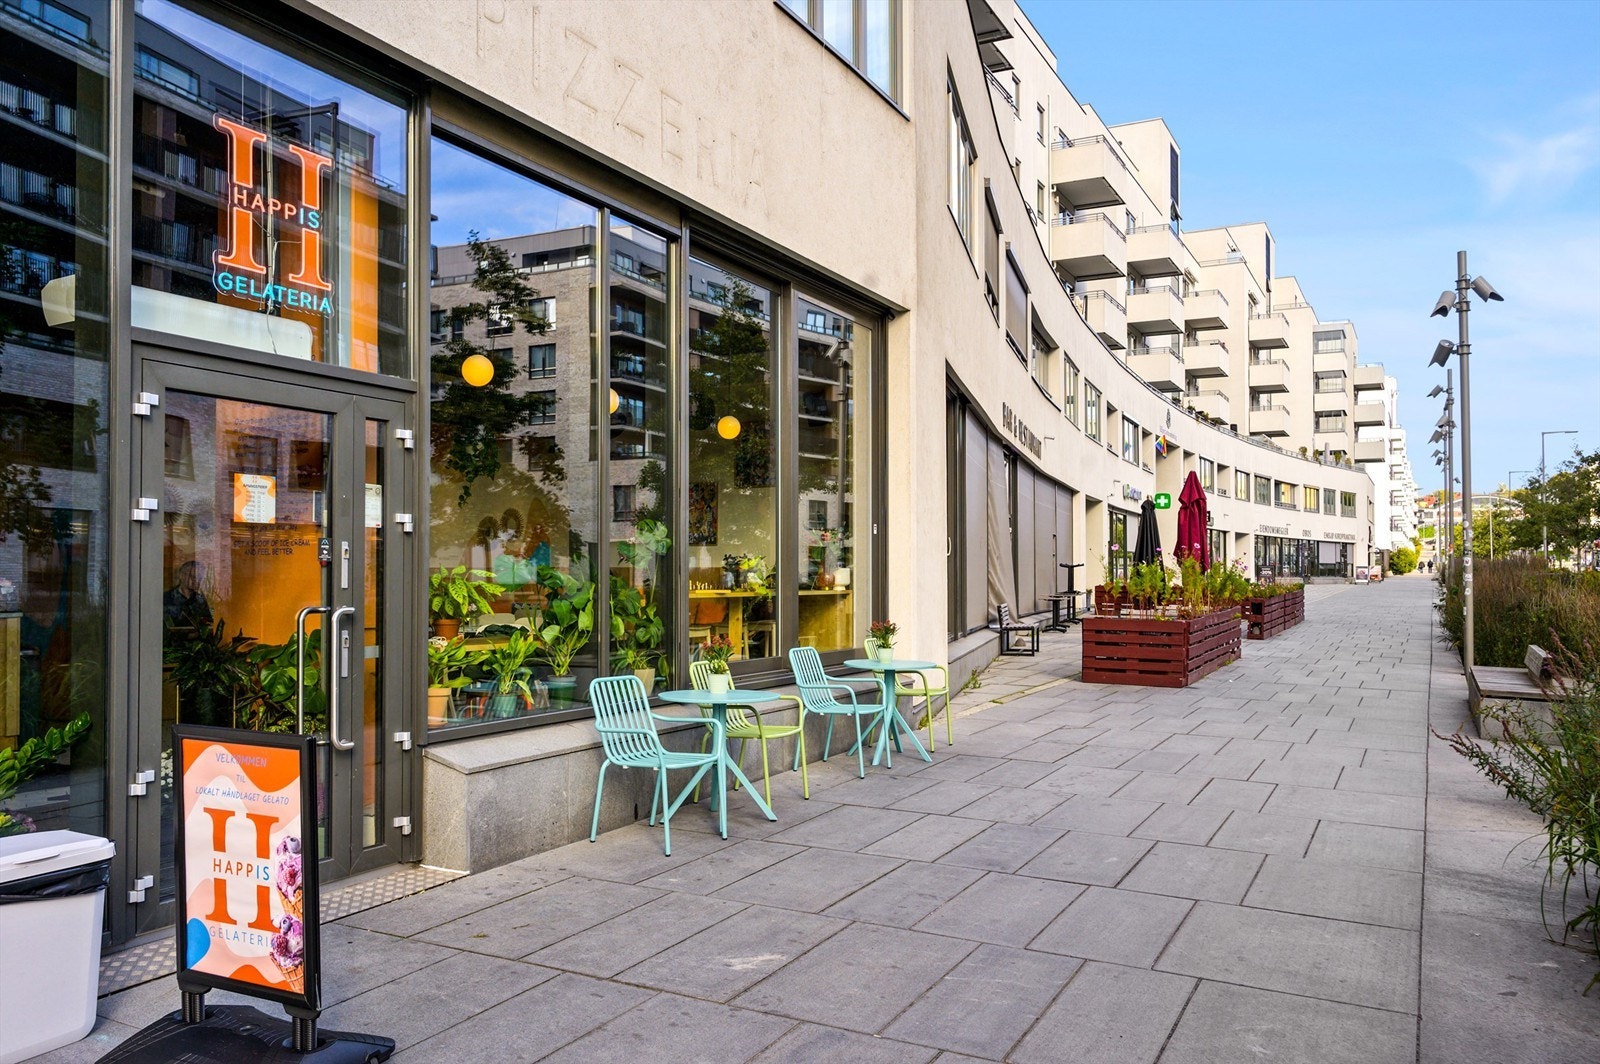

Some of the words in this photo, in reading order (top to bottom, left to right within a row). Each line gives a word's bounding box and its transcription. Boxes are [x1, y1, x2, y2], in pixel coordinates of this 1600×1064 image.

[233, 186, 320, 229] HAPPIS
[217, 272, 332, 314] GELATERIA
[215, 752, 268, 768] VELKOMMEN
[236, 774, 246, 783] TIL
[195, 786, 220, 796] LOKALT
[221, 787, 260, 802] HÅNDLAGET
[262, 794, 290, 806] GELATO
[213, 857, 270, 881] HAPPIS
